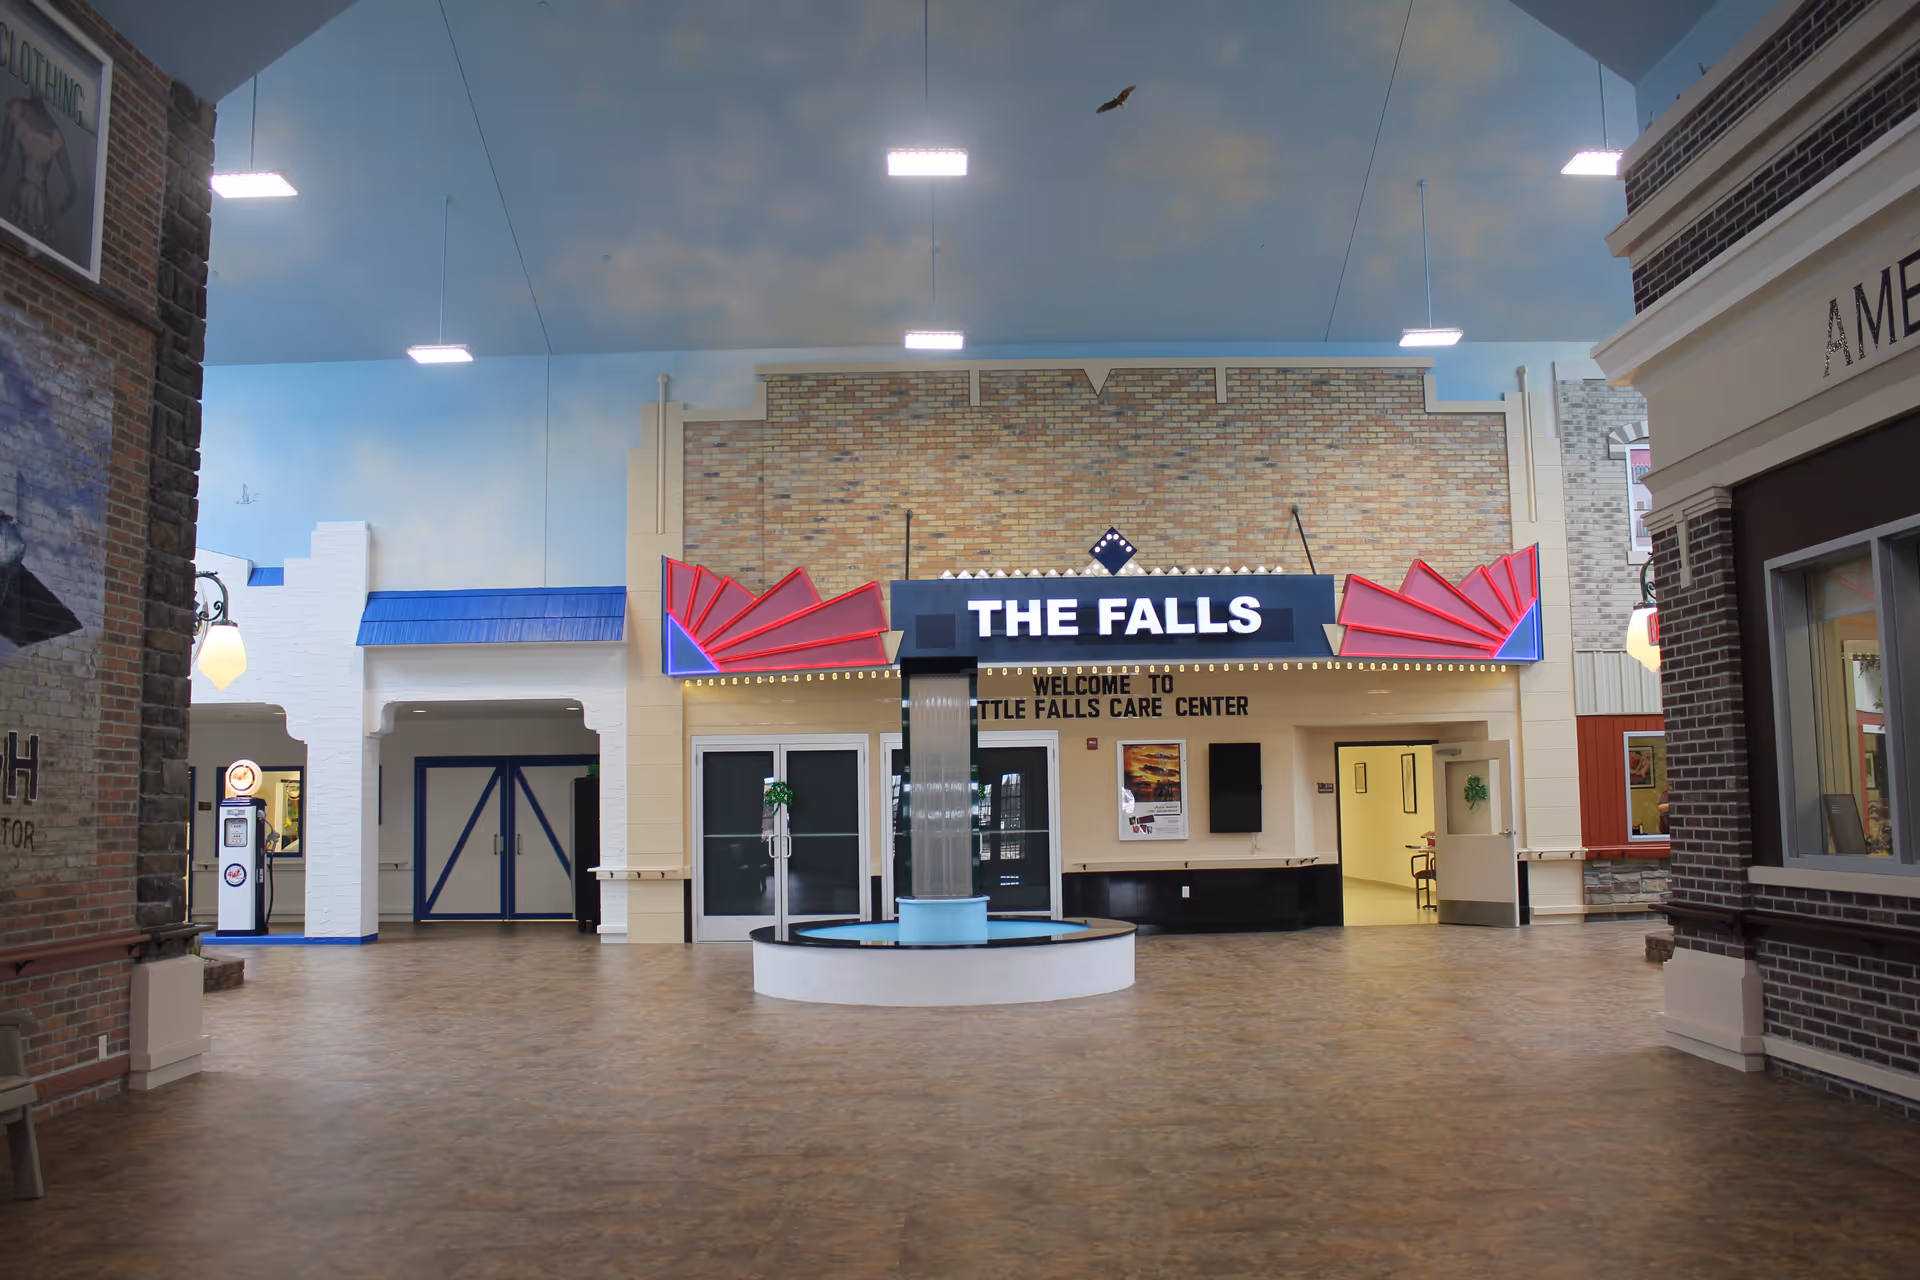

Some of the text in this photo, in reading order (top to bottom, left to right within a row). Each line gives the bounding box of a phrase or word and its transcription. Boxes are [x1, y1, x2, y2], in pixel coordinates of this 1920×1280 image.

[1823, 249, 1920, 379] AME
[967, 596, 1262, 637] THE FALLS
[1033, 674, 1174, 696] WELCOME TO
[1035, 697, 1100, 719] FALLS
[1109, 697, 1163, 718] CARE
[1176, 695, 1249, 717] CENTER
[0, 729, 39, 804] H
